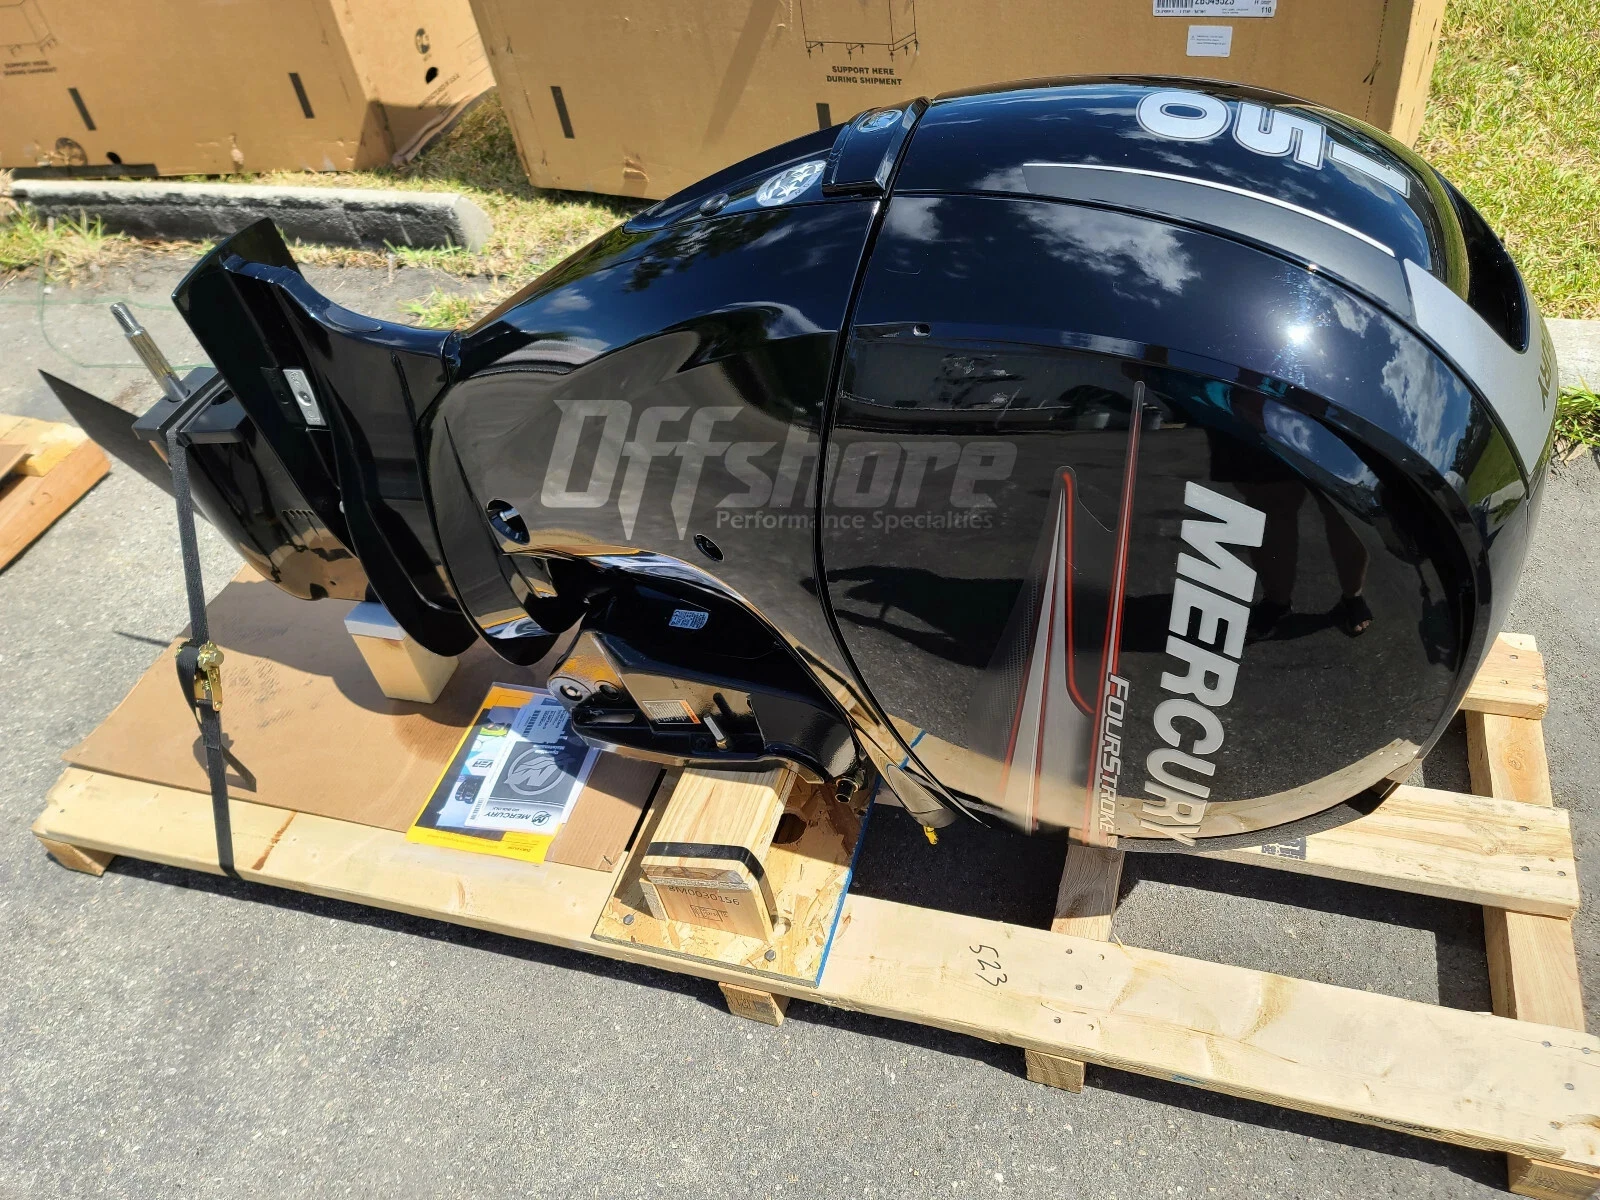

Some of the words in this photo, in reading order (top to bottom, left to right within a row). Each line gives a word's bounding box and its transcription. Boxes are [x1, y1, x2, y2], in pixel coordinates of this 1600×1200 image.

[826, 75, 858, 83] DURING
[860, 77, 902, 85] SHIPMENT
[832, 66, 869, 74] SUPPORT
[872, 67, 895, 75] HERE
[1135, 90, 1411, 199] 150
[1140, 480, 1266, 847] MERCURY
[1100, 672, 1131, 834] FOURSTROKE
[484, 811, 532, 821] MERCURY
[668, 885, 740, 906] 8M0030156
[968, 944, 1008, 987] 523
